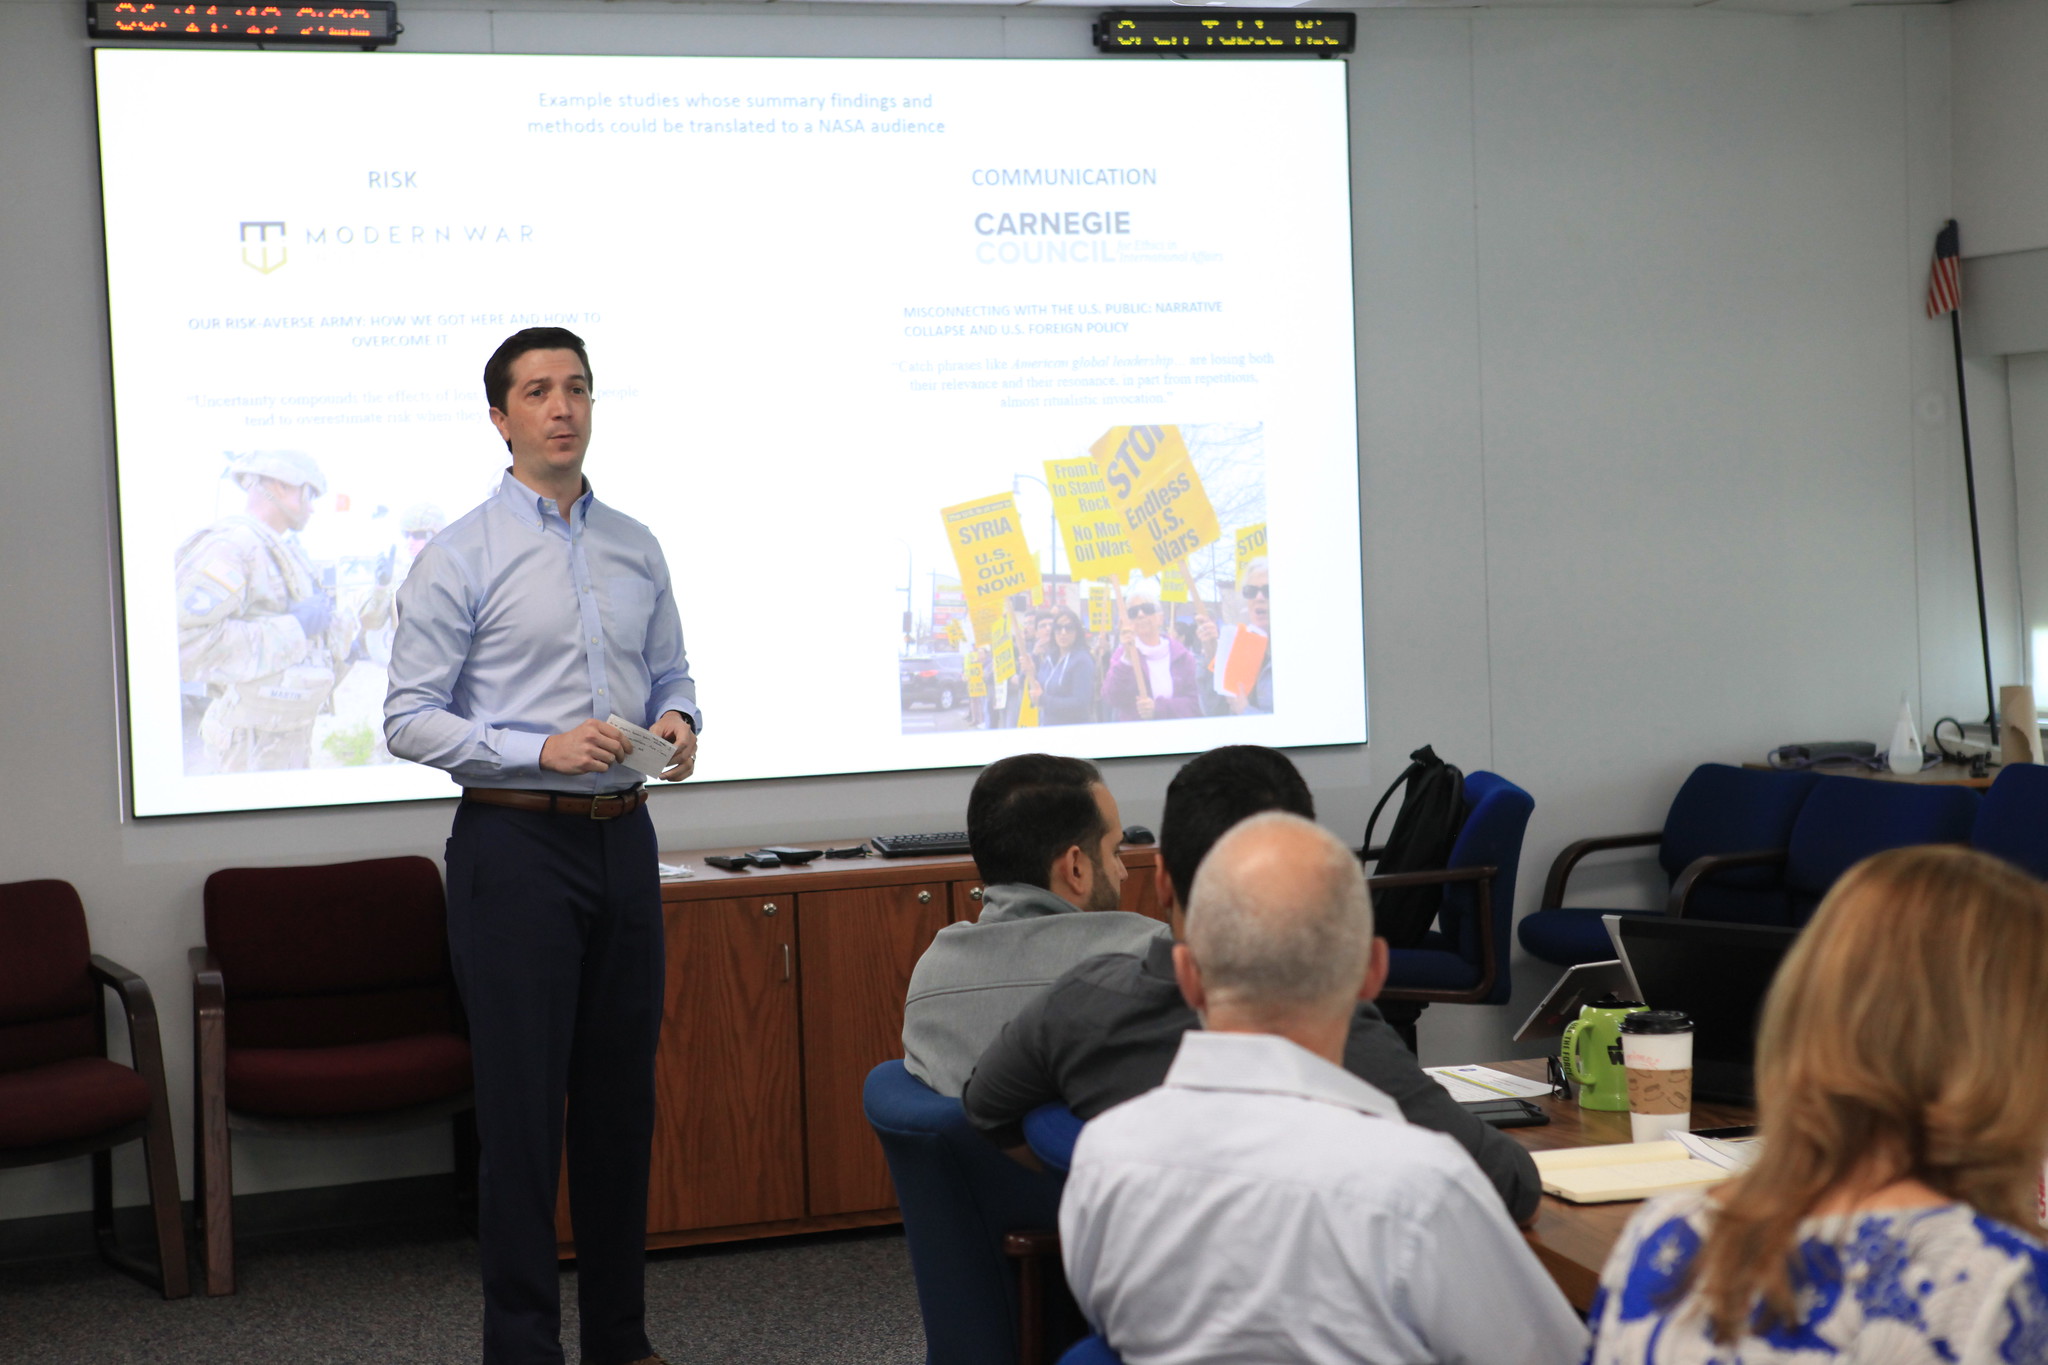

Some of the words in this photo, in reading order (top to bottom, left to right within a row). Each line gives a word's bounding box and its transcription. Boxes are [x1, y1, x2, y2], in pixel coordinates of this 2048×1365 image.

[539, 92, 612, 110] Example
[618, 92, 680, 108] studies
[685, 93, 741, 108] whose
[746, 96, 826, 112] summary
[830, 92, 897, 112] findings
[902, 93, 933, 108] and
[528, 118, 605, 133] methods
[610, 118, 657, 133] could
[663, 118, 684, 133] be
[689, 118, 776, 133] translated
[781, 120, 799, 133] to
[804, 122, 813, 133] a
[818, 119, 866, 133] NASA
[870, 118, 945, 133] audience
[368, 171, 417, 189] RISK
[972, 168, 1157, 186] COMMUNICATION
[974, 211, 1130, 236] CARNEGIE
[306, 225, 450, 244] MODERN
[464, 225, 533, 243] WAR
[976, 240, 1115, 264] COUNCIL
[903, 305, 1011, 318] MISCONNECTING
[1013, 304, 1048, 316] WITH
[1051, 304, 1074, 315] THE
[1078, 304, 1102, 315] U.S.
[1105, 302, 1153, 314] PUBLIC:
[1155, 301, 1223, 314] NARRATIVE
[188, 318, 221, 330] OUR
[225, 317, 315, 329] RISK-AVERSE
[320, 316, 366, 328] ARMY:
[370, 315, 406, 327] HOW
[410, 314, 432, 326] WE
[437, 314, 465, 326] GOT
[471, 313, 504, 325] HERE
[509, 313, 540, 325] AND
[544, 313, 578, 324] HOW
[584, 312, 601, 323] TO
[904, 325, 965, 337] COLLAPSE
[970, 324, 998, 336] AND
[1001, 324, 1025, 336] U.S.
[1028, 322, 1084, 335] FOREIGN
[1086, 321, 1129, 334] POLICY
[352, 335, 432, 347] OVERCOME
[436, 334, 448, 345] IT
[937, 359, 982, 375] phrases
[985, 358, 1008, 370] like
[1011, 357, 1068, 369] American
[1072, 355, 1110, 371] global
[1189, 355, 1207, 366] are
[1211, 352, 1246, 367] losing
[1248, 352, 1275, 364] both
[910, 377, 937, 391] their
[942, 377, 999, 391] relevance
[1002, 376, 1024, 389] and
[1027, 376, 1054, 388] their
[1137, 375, 1160, 388] part
[1164, 372, 1192, 385] from
[280, 391, 358, 408] compounds
[363, 390, 383, 403] the
[387, 388, 431, 402] effects
[436, 388, 450, 401] of
[597, 385, 640, 401] people
[1000, 395, 1041, 409] almost
[1044, 394, 1098, 407] ritualistic
[245, 412, 276, 427] tend
[279, 413, 293, 426] to
[296, 413, 383, 424] overestimate
[387, 411, 412, 423] risk
[416, 410, 452, 422] when
[456, 409, 484, 424] they
[1054, 464, 1086, 479] From
[1052, 484, 1067, 497] to
[1070, 479, 1106, 496] Stand
[1079, 496, 1111, 513] Rock
[1124, 472, 1191, 530] Endless
[959, 516, 1013, 545] SYRIA
[1072, 524, 1093, 542] No
[1094, 521, 1123, 538] Mor
[1147, 507, 1184, 541] U.S.
[975, 548, 1011, 565] U.S.
[1075, 541, 1095, 562] Oil
[1152, 528, 1200, 566] Wars
[978, 560, 1015, 580] OUT
[977, 572, 1025, 597] NOW!
